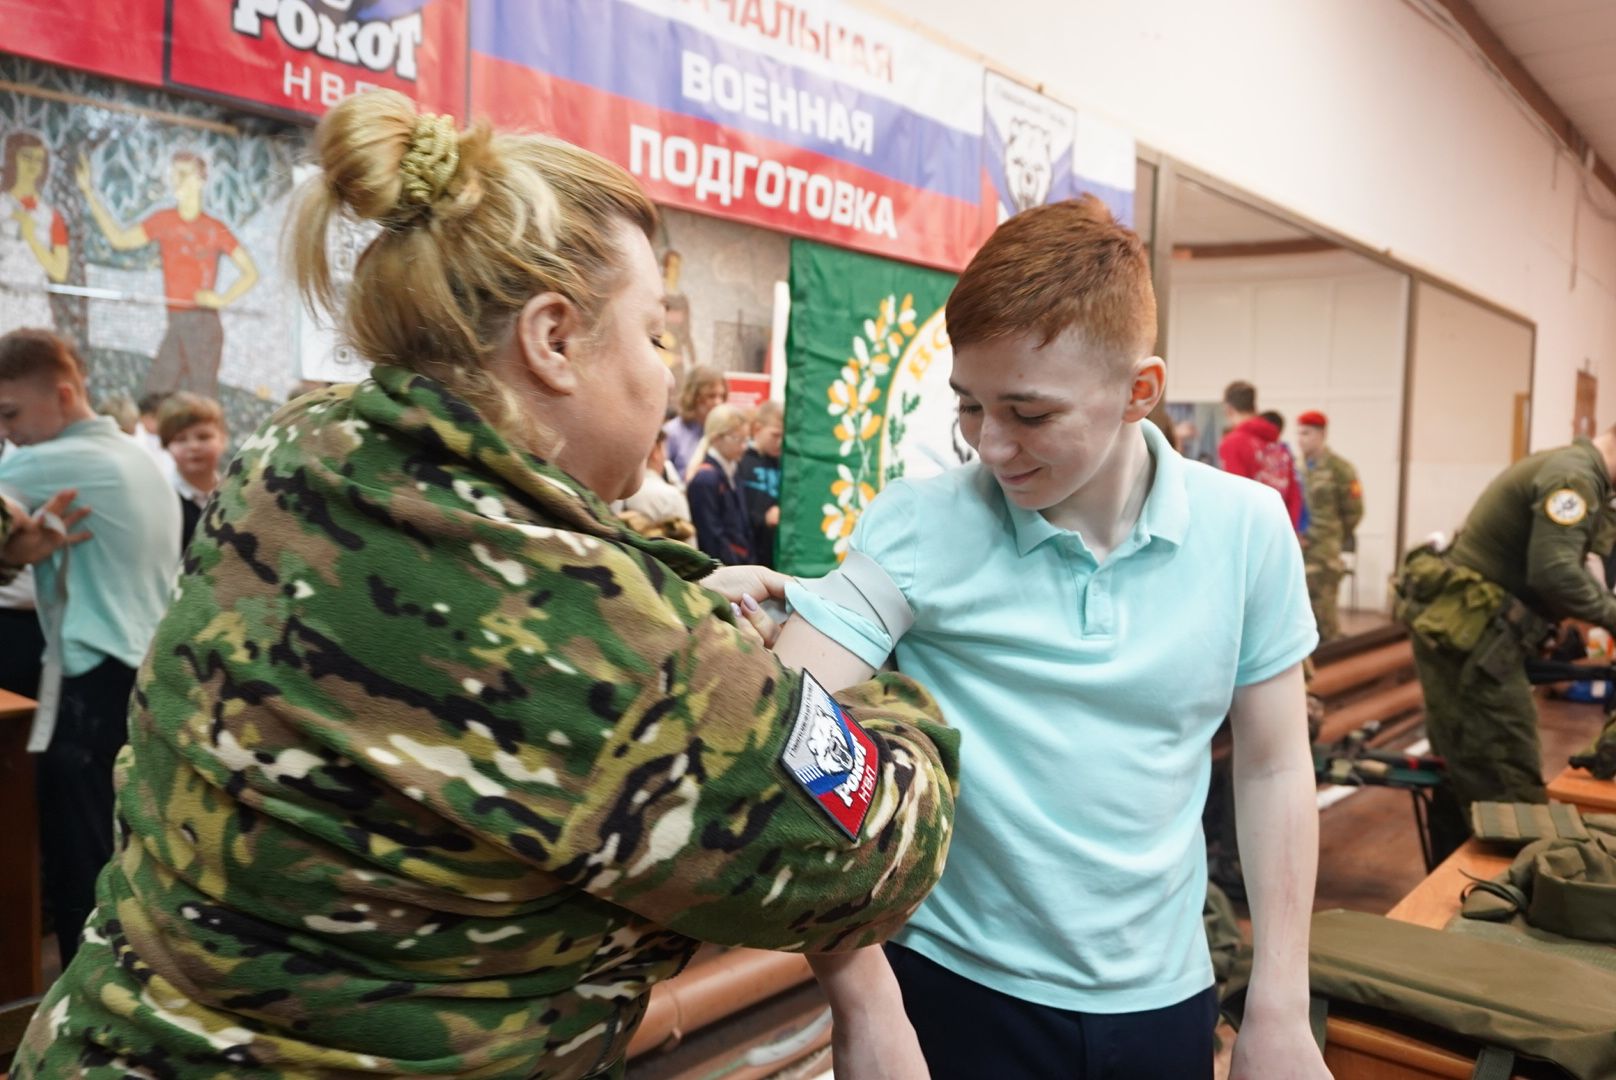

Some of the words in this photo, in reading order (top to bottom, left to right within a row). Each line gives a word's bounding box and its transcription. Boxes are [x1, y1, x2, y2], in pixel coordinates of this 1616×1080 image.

[681, 50, 875, 155] ВОЕННАЯ
[629, 123, 898, 240] ПОДГОТОВКА
[858, 763, 876, 804] НВП
